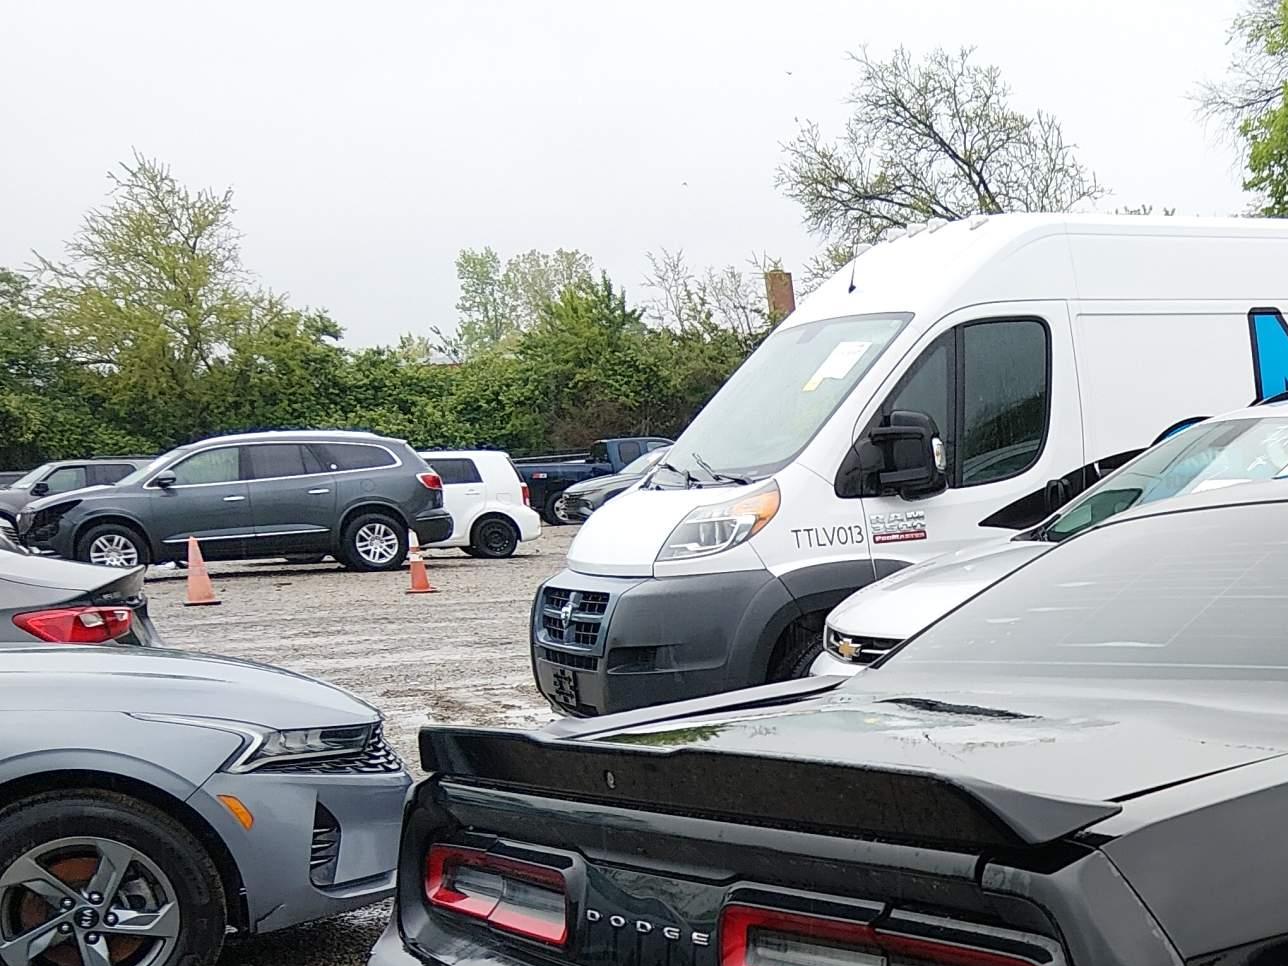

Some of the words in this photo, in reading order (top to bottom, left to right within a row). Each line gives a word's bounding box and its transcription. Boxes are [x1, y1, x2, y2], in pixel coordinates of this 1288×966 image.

[790, 524, 864, 549] TTLV013
[80, 908, 94, 927] KIA
[586, 908, 710, 946] DODGE
